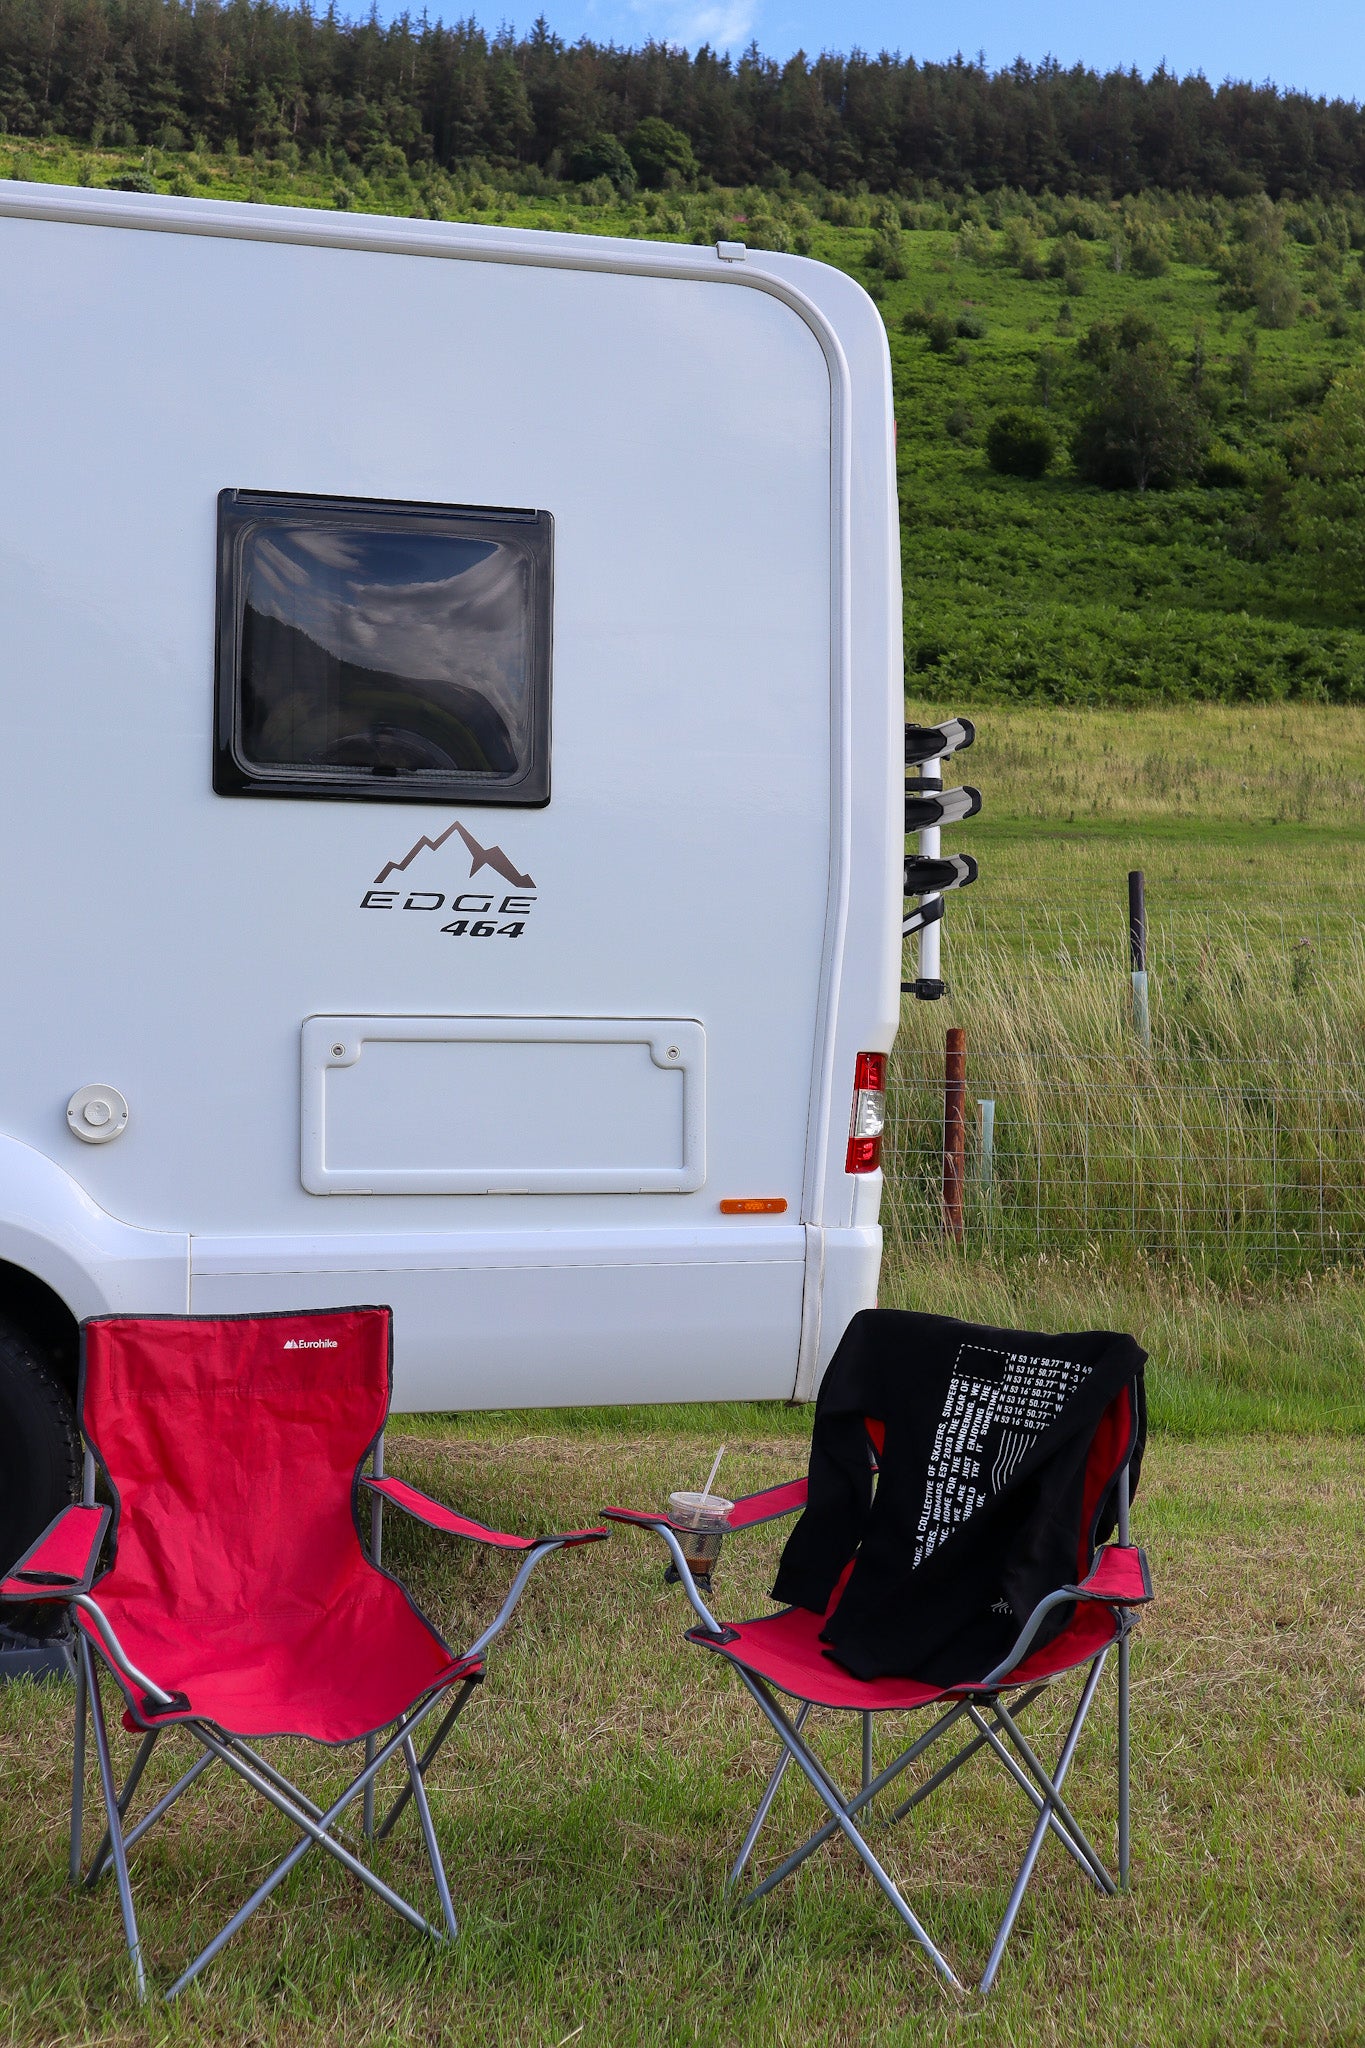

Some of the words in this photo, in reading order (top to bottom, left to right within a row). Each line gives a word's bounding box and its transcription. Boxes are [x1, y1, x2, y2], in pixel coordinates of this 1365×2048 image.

[360, 890, 538, 914] EDGE
[440, 920, 526, 938] 464
[298, 1338, 338, 1348] Eurohike
[1018, 1355, 1027, 1363] 53
[1064, 1361, 1071, 1369] W
[1009, 1364, 1014, 1372] N
[1062, 1372, 1069, 1380] W
[960, 1380, 970, 1392] OF
[971, 1383, 981, 1396] WE
[1006, 1374, 1012, 1382] N
[1060, 1382, 1066, 1390] W
[942, 1378, 959, 1418] SURFERS
[979, 1385, 991, 1401] THE
[1003, 1384, 1009, 1392] N
[1057, 1393, 1064, 1401] W
[954, 1394, 966, 1416] YEAR
[980, 1387, 1000, 1435] SOMETIME.
[1000, 1394, 1006, 1402] N
[1056, 1404, 1063, 1412] W
[1004, 1406, 1013, 1414] 53
[948, 1418, 960, 1434] THE
[954, 1400, 976, 1453] WANDERING.
[994, 1414, 1000, 1422] N
[1001, 1415, 1010, 1423] 53
[967, 1408, 984, 1451] ENJOYING
[930, 1422, 948, 1461] SKATERS,
[943, 1437, 954, 1460] 2020
[975, 1443, 983, 1452] IT
[928, 1464, 936, 1476] OF
[938, 1461, 949, 1478] EST
[951, 1456, 961, 1473] THE
[962, 1456, 972, 1479] JUST
[971, 1460, 980, 1478] TRY
[946, 1476, 957, 1494] FOR
[957, 1484, 966, 1502] ARE
[918, 1480, 934, 1531] COLLECTIVE
[933, 1480, 944, 1520] NOMADS.
[976, 1493, 986, 1507] UK.
[943, 1497, 952, 1523] HOME
[954, 1508, 961, 1521] WE
[912, 1546, 923, 1570] ADIC,
